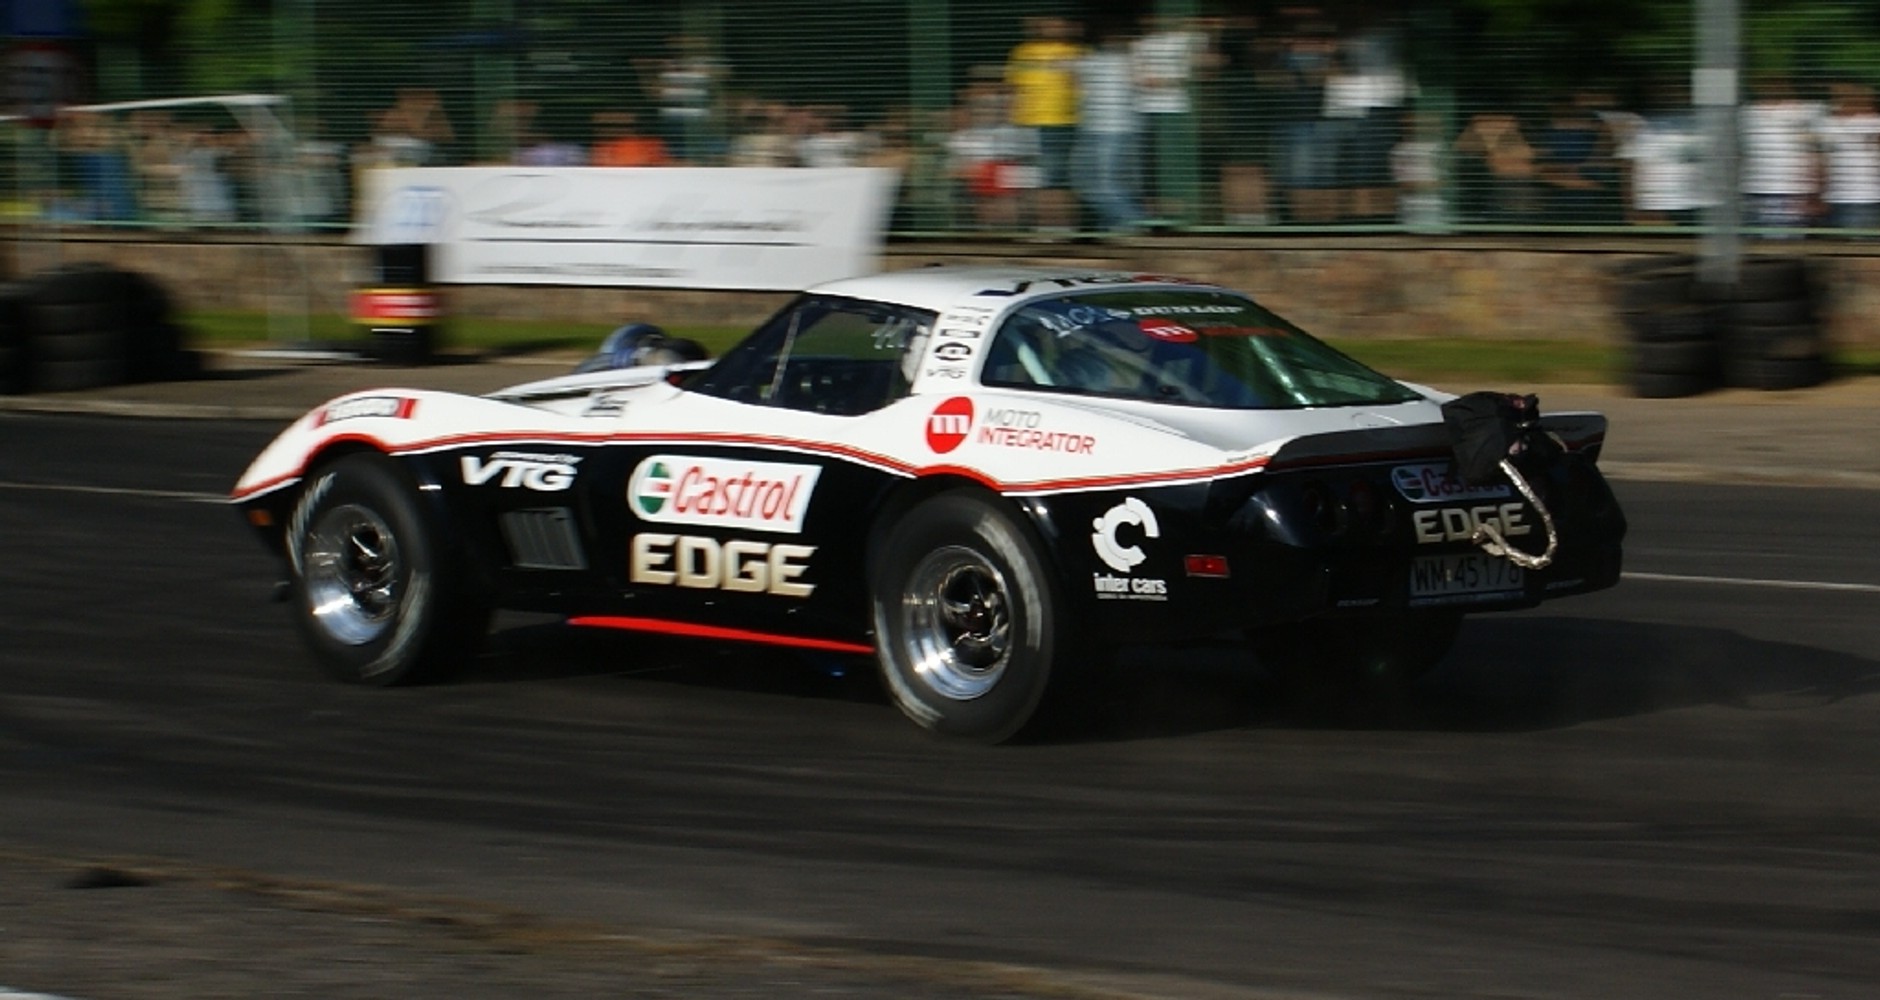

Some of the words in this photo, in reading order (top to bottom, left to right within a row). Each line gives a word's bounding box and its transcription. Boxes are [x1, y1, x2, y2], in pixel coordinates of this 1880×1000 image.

[983, 407, 1041, 428] MOTO
[977, 427, 1096, 455] INTEGRATOR
[461, 455, 578, 492] VTG
[674, 466, 803, 521] Castrol
[1413, 503, 1532, 544] EDGE
[629, 532, 819, 597] EDGE
[1414, 559, 1447, 591] WM
[1093, 572, 1130, 592] inter
